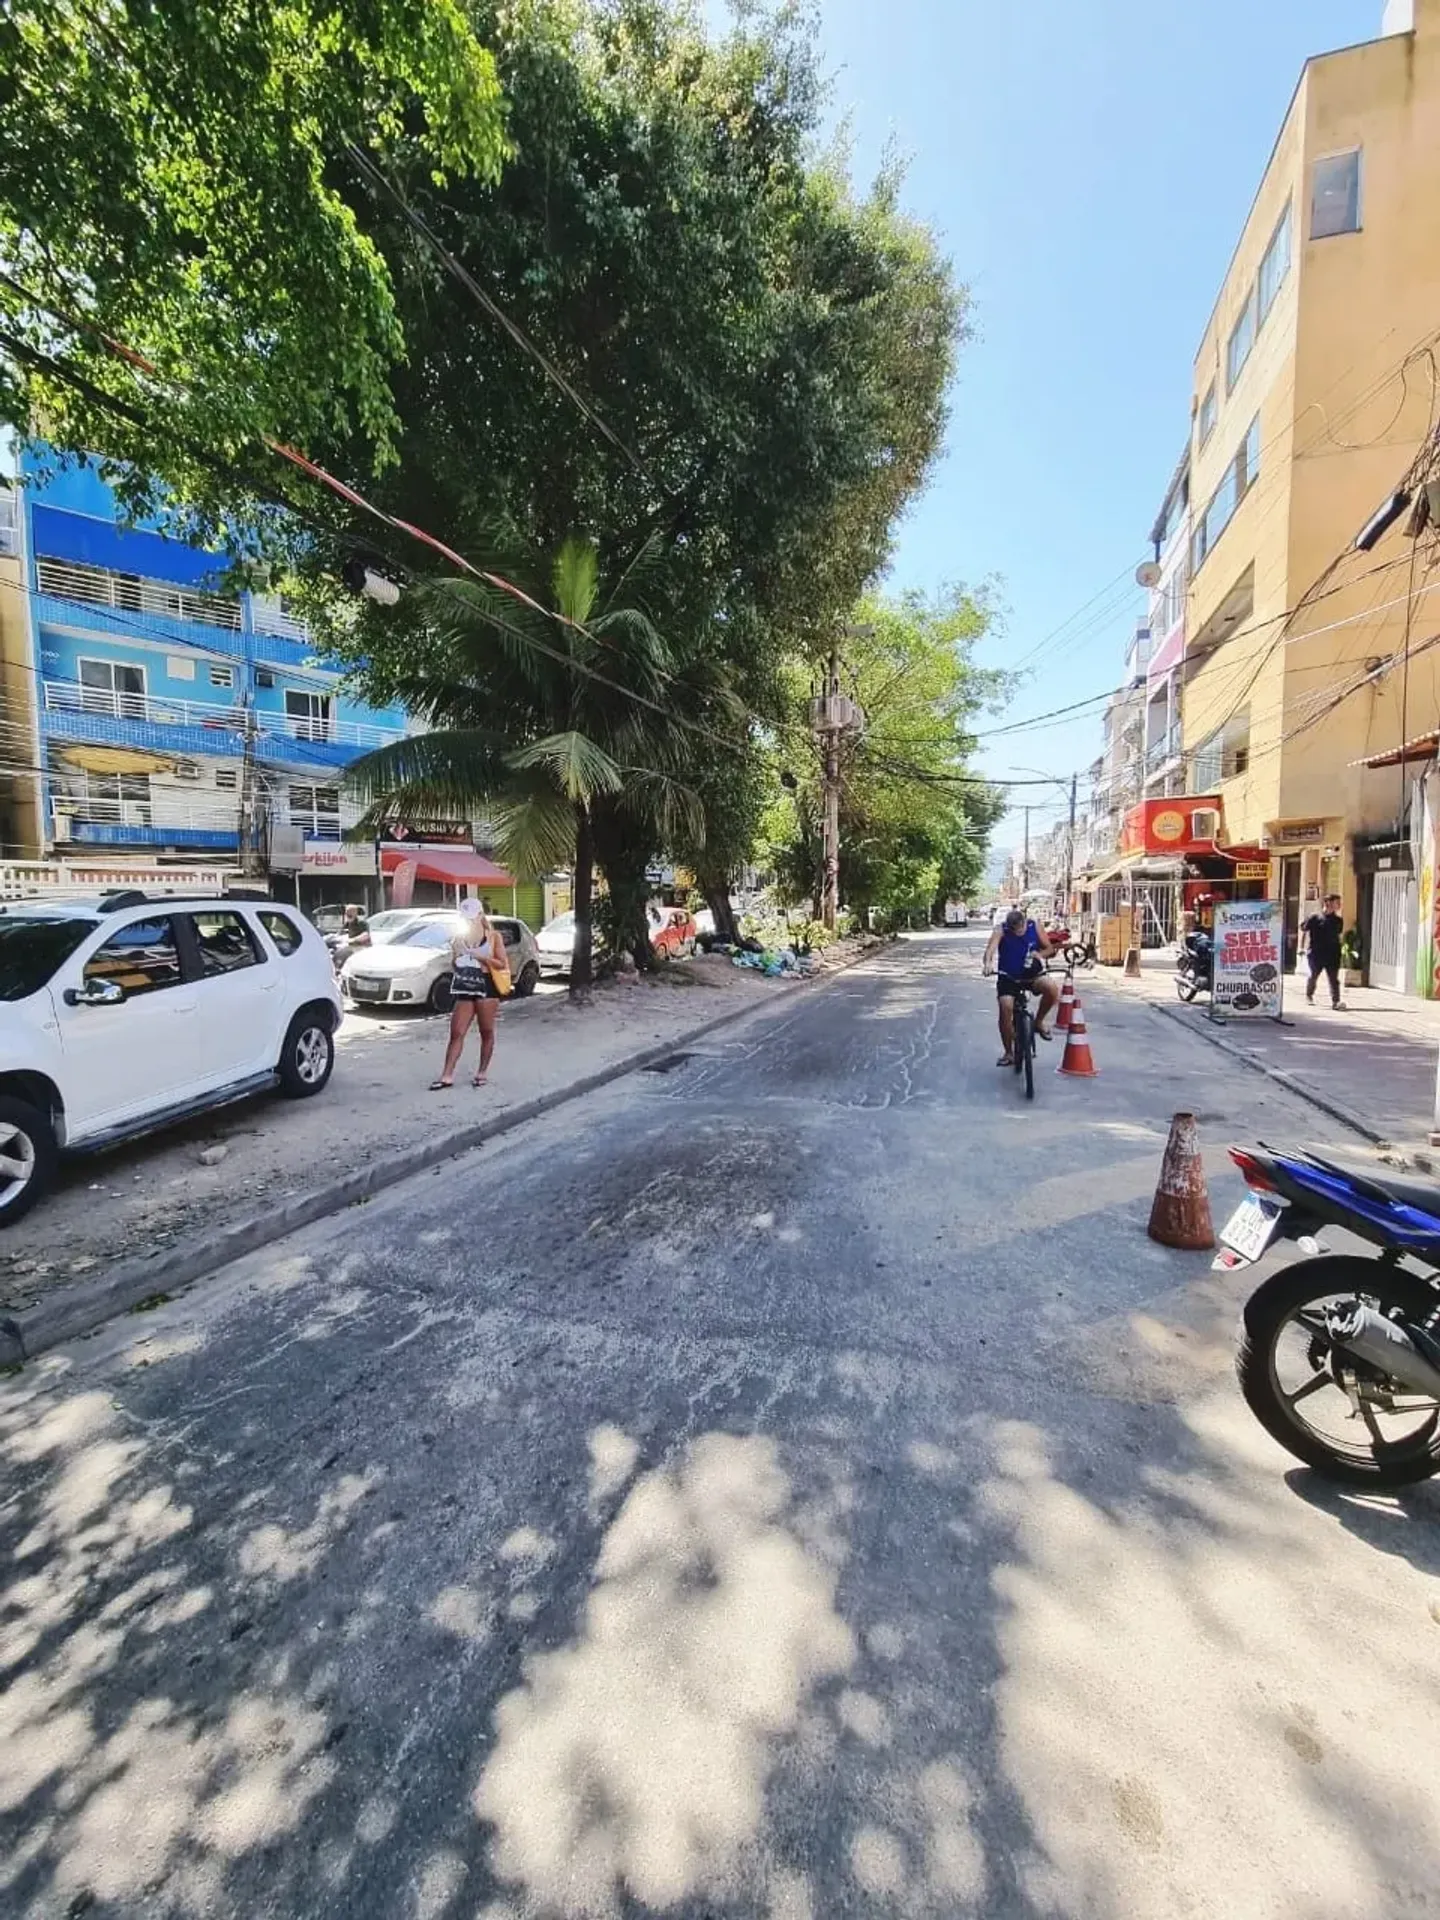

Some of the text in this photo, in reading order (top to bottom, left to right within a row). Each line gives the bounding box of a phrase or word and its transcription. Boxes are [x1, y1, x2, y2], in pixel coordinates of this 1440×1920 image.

[1224, 930, 1271, 948] SELF
[1219, 944, 1278, 965] SERVICE
[1216, 982, 1277, 993] CHURRASCO
